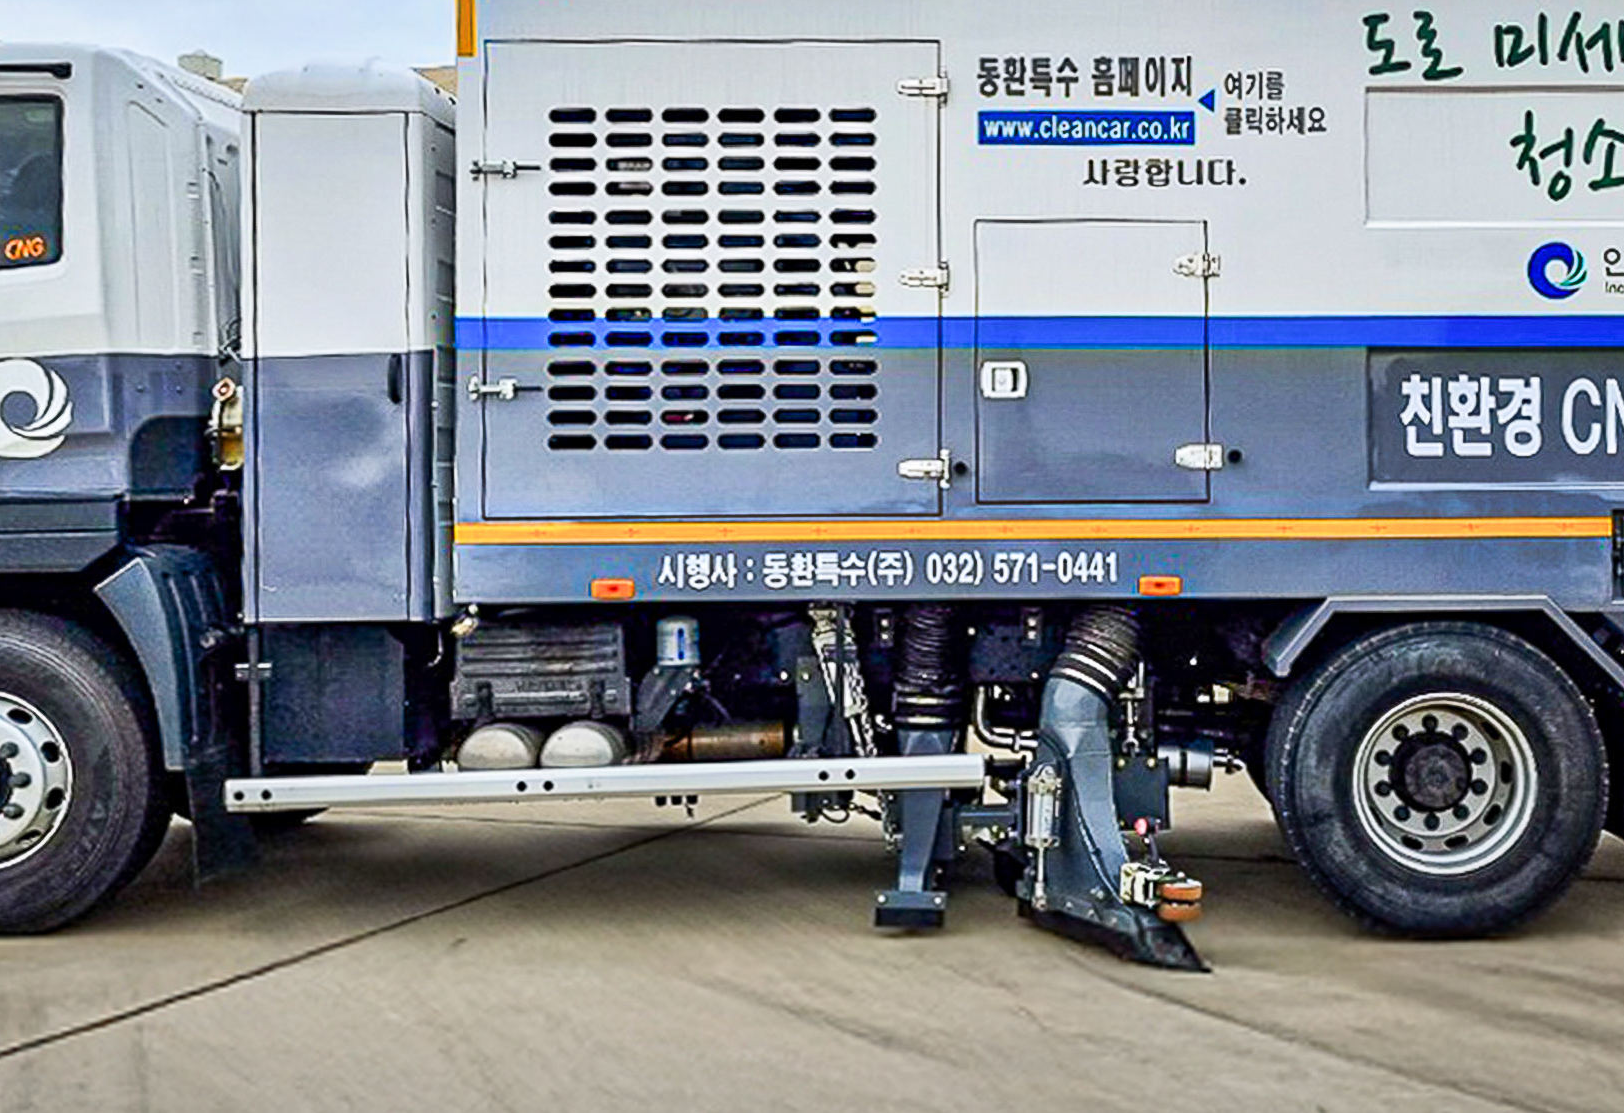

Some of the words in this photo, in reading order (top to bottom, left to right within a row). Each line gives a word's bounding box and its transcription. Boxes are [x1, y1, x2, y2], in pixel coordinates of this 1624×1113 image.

[1363, 11, 1463, 80] 도로
[977, 57, 1079, 97] 동환특수
[1091, 56, 1193, 97] 홈페이지
[1224, 71, 1285, 100] 여기를
[983, 115, 1190, 140] www.cleancar.co.kr
[1224, 106, 1327, 135] 클릭하세요
[1083, 158, 1248, 187] 사랑합니다.
[5, 237, 44, 260] CNG
[1400, 374, 1544, 457] 친환경
[657, 552, 737, 590] 시행사
[762, 550, 914, 589] 동환특수(주)
[926, 551, 984, 585] 032)
[992, 551, 1118, 585] 571-0441
